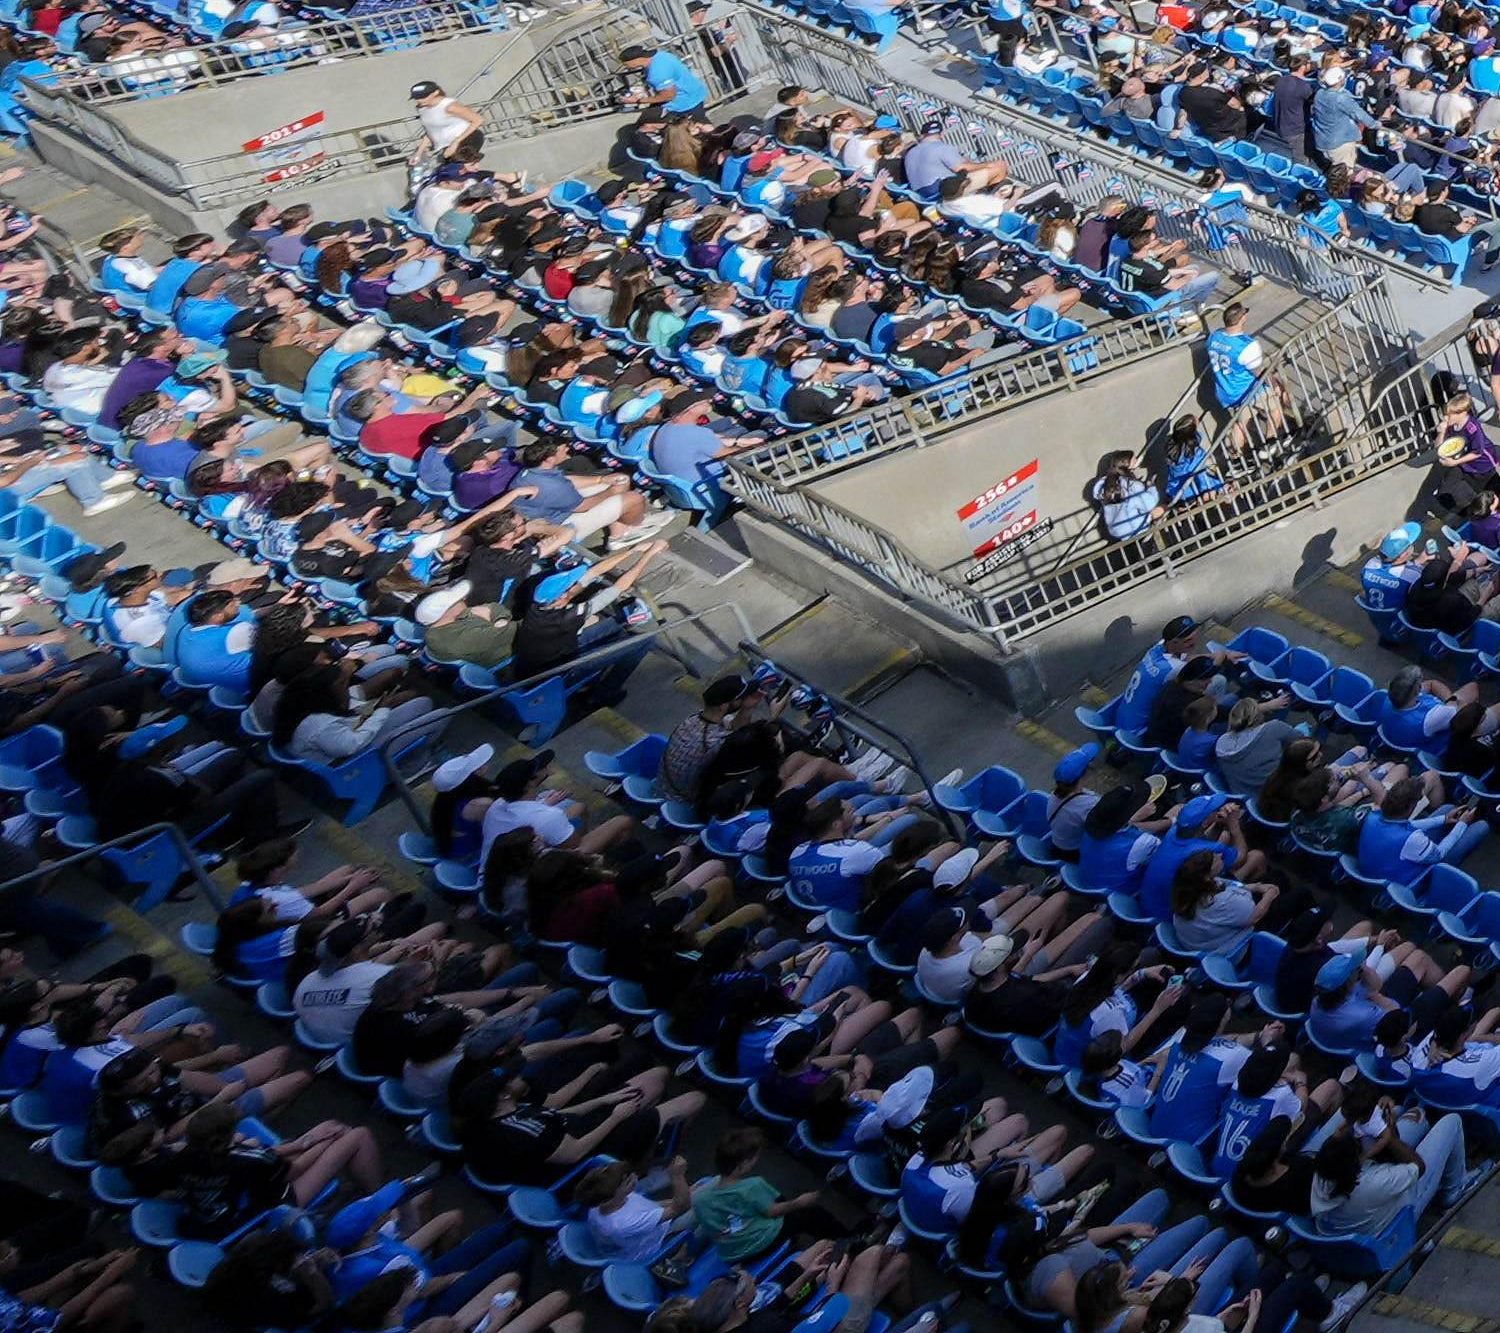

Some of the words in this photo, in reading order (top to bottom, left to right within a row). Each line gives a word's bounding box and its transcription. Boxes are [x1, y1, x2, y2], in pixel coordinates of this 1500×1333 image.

[974, 482, 1008, 510] 256
[991, 523, 1022, 549] 140
[1218, 1113, 1252, 1162] 16
